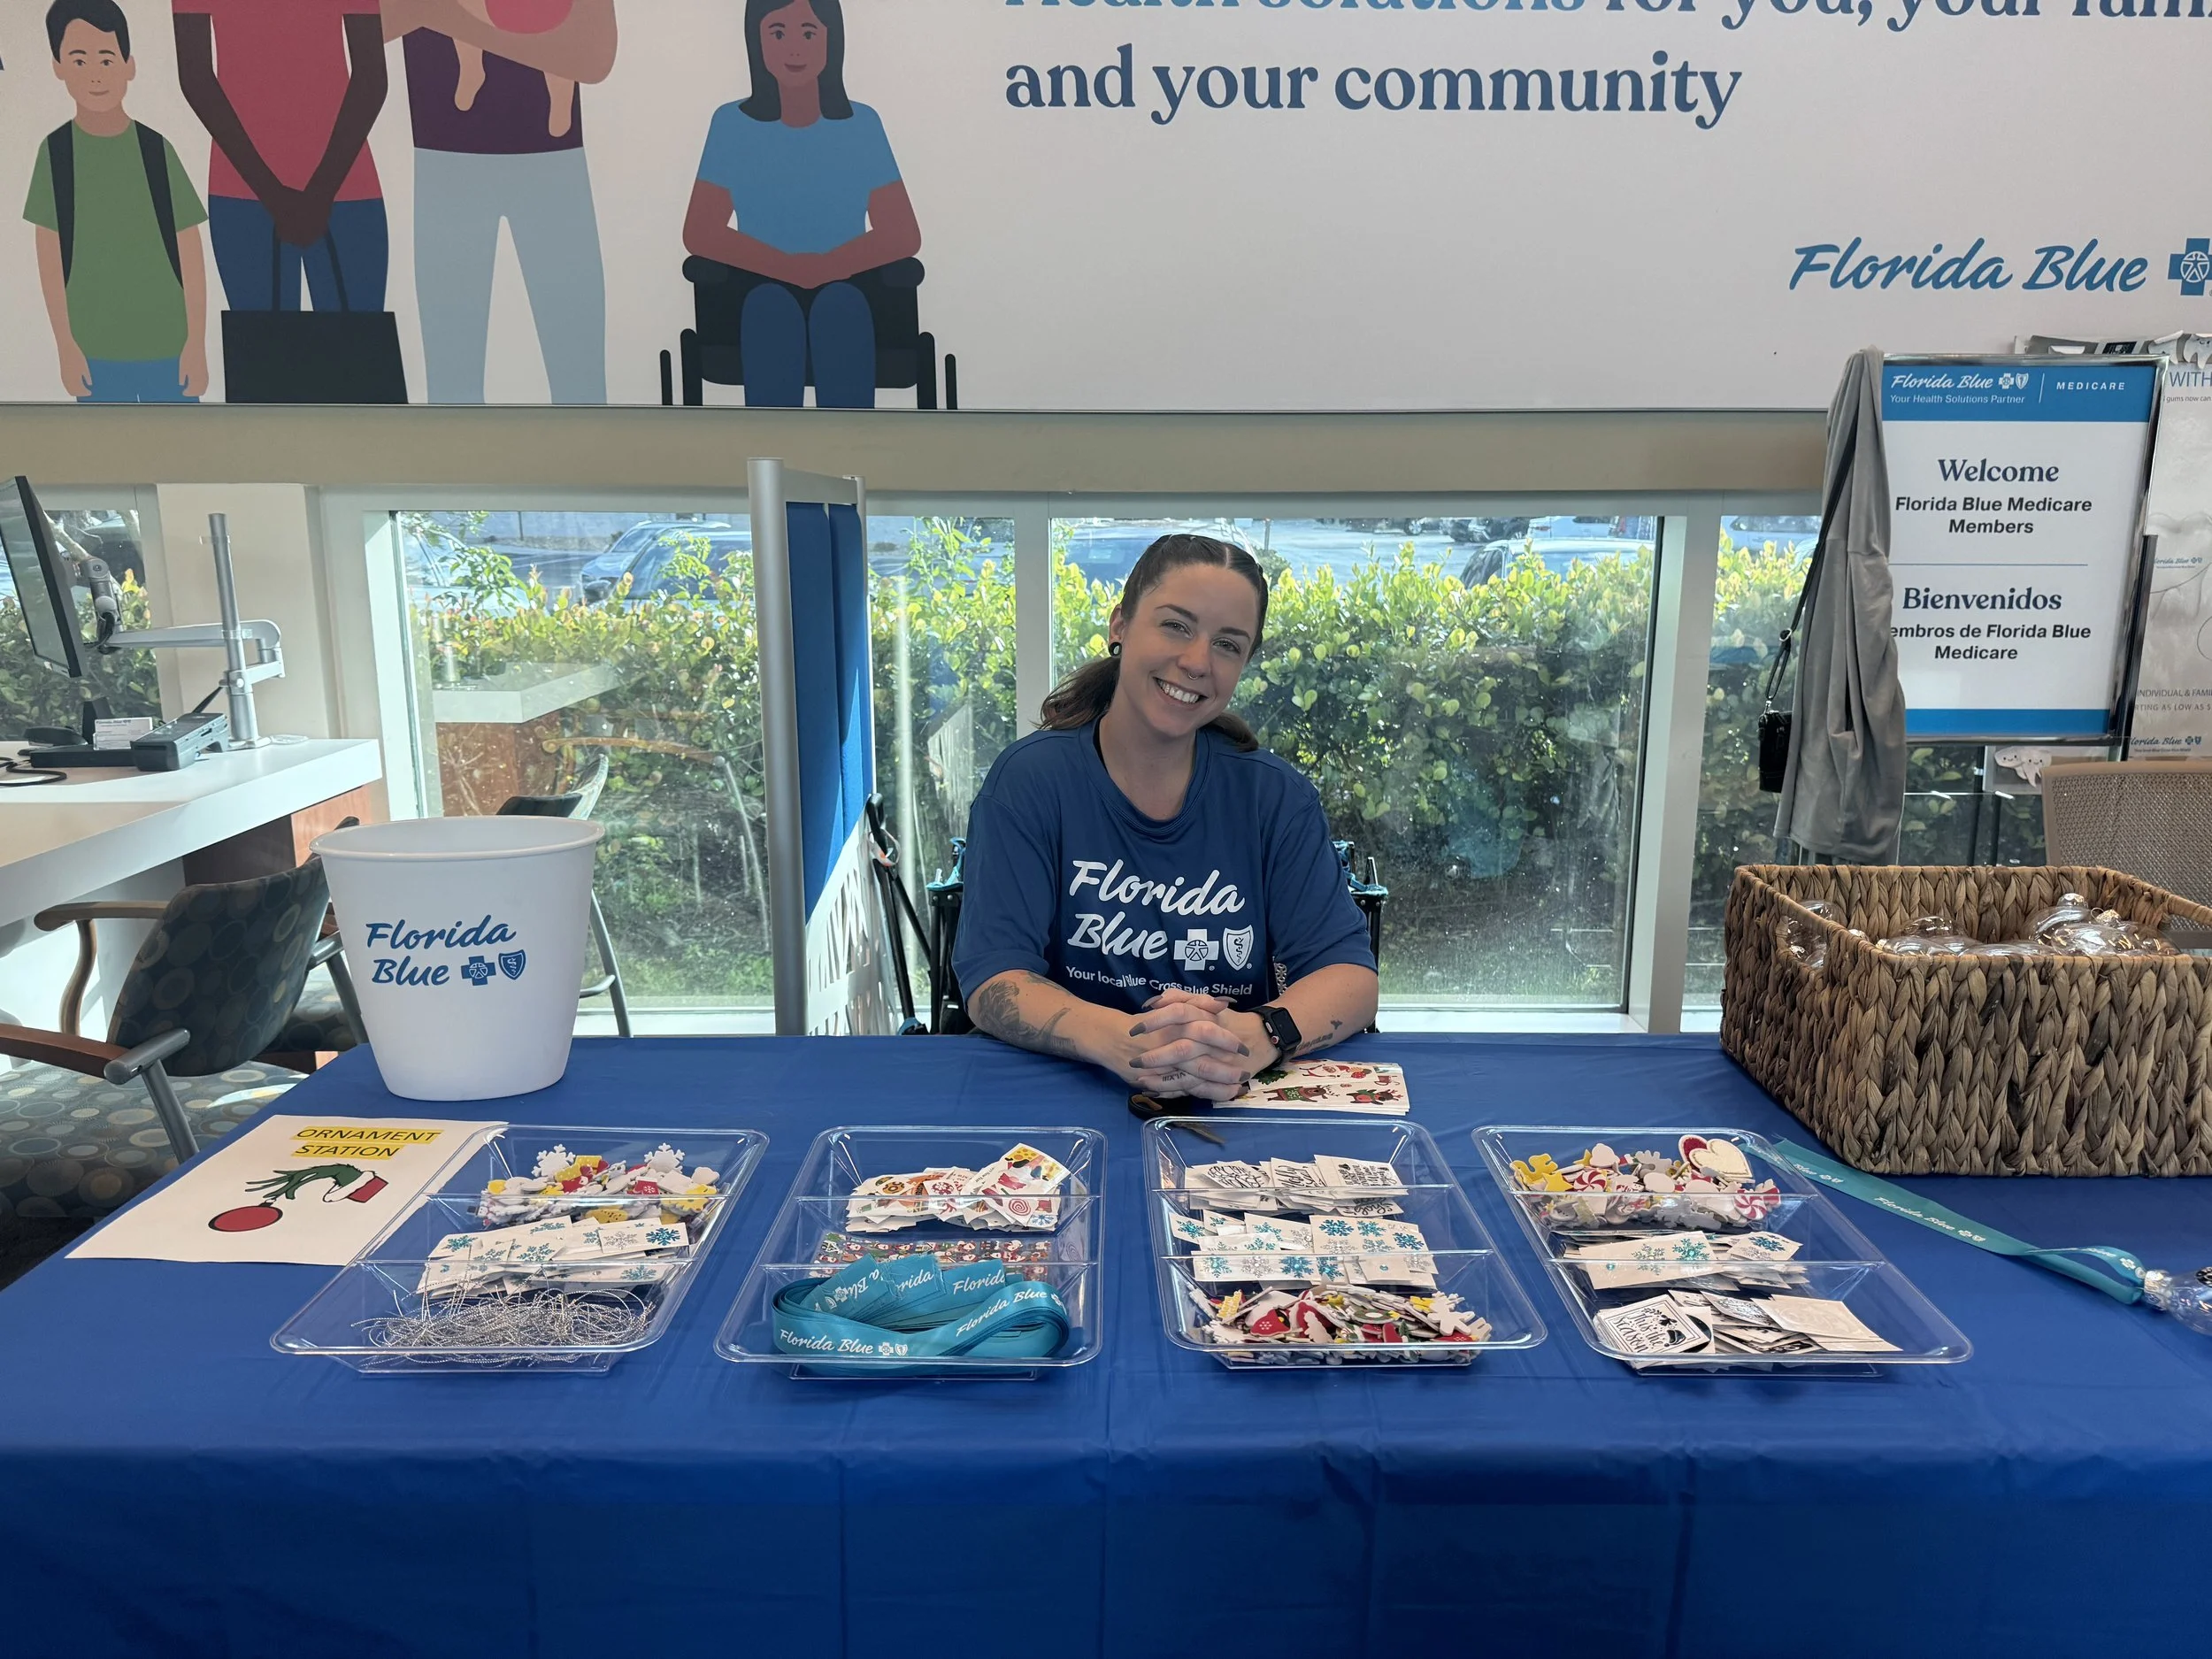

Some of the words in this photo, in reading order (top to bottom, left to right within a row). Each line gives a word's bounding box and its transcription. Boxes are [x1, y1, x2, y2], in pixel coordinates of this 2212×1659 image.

[1005, 42, 1135, 108] and
[1150, 65, 1318, 126] your
[1334, 50, 1743, 130] community
[1789, 236, 2013, 291] Florida
[2022, 237, 2148, 292] Blue
[1891, 373, 1955, 389] Florida
[1956, 373, 1993, 389] Blue
[2056, 381, 2125, 390] MEDICARE
[1890, 395, 1910, 403] Your
[1912, 395, 1944, 403] Health
[1945, 395, 1989, 403] Solutions
[1991, 395, 2026, 403] Partner
[1938, 458, 2060, 482] Welcome
[1895, 496, 1957, 511] Florida
[1962, 496, 2002, 511] Blue
[2007, 497, 2093, 512] Medicare
[1948, 518, 2034, 534] Members
[1902, 588, 2062, 611] Bienvenidos
[1890, 624, 1955, 638] embros
[1959, 624, 1982, 639] de
[1986, 624, 2047, 639] Florida
[2052, 624, 2092, 639] Blue
[1934, 645, 2018, 660] Medicare
[2130, 737, 2160, 746] lorida
[2162, 736, 2183, 745] Blue
[1069, 858, 1246, 916] Florida
[365, 914, 517, 950] Florida
[1067, 911, 1168, 961] Blue
[372, 956, 450, 986] Blue
[1065, 965, 1095, 980] Your
[1098, 971, 1126, 987] local
[1211, 983, 1253, 995] Shield
[296, 1128, 442, 1141] ORNAMENT
[295, 1144, 400, 1157] STATION
[1874, 1196, 1924, 1218] Florida
[1923, 1217, 1955, 1231] Blue
[898, 1269, 934, 1291] rida
[956, 1300, 1010, 1337] Florida
[1012, 1288, 1048, 1303] Blue
[780, 1329, 834, 1351] Florida
[837, 1339, 874, 1354] Blue
